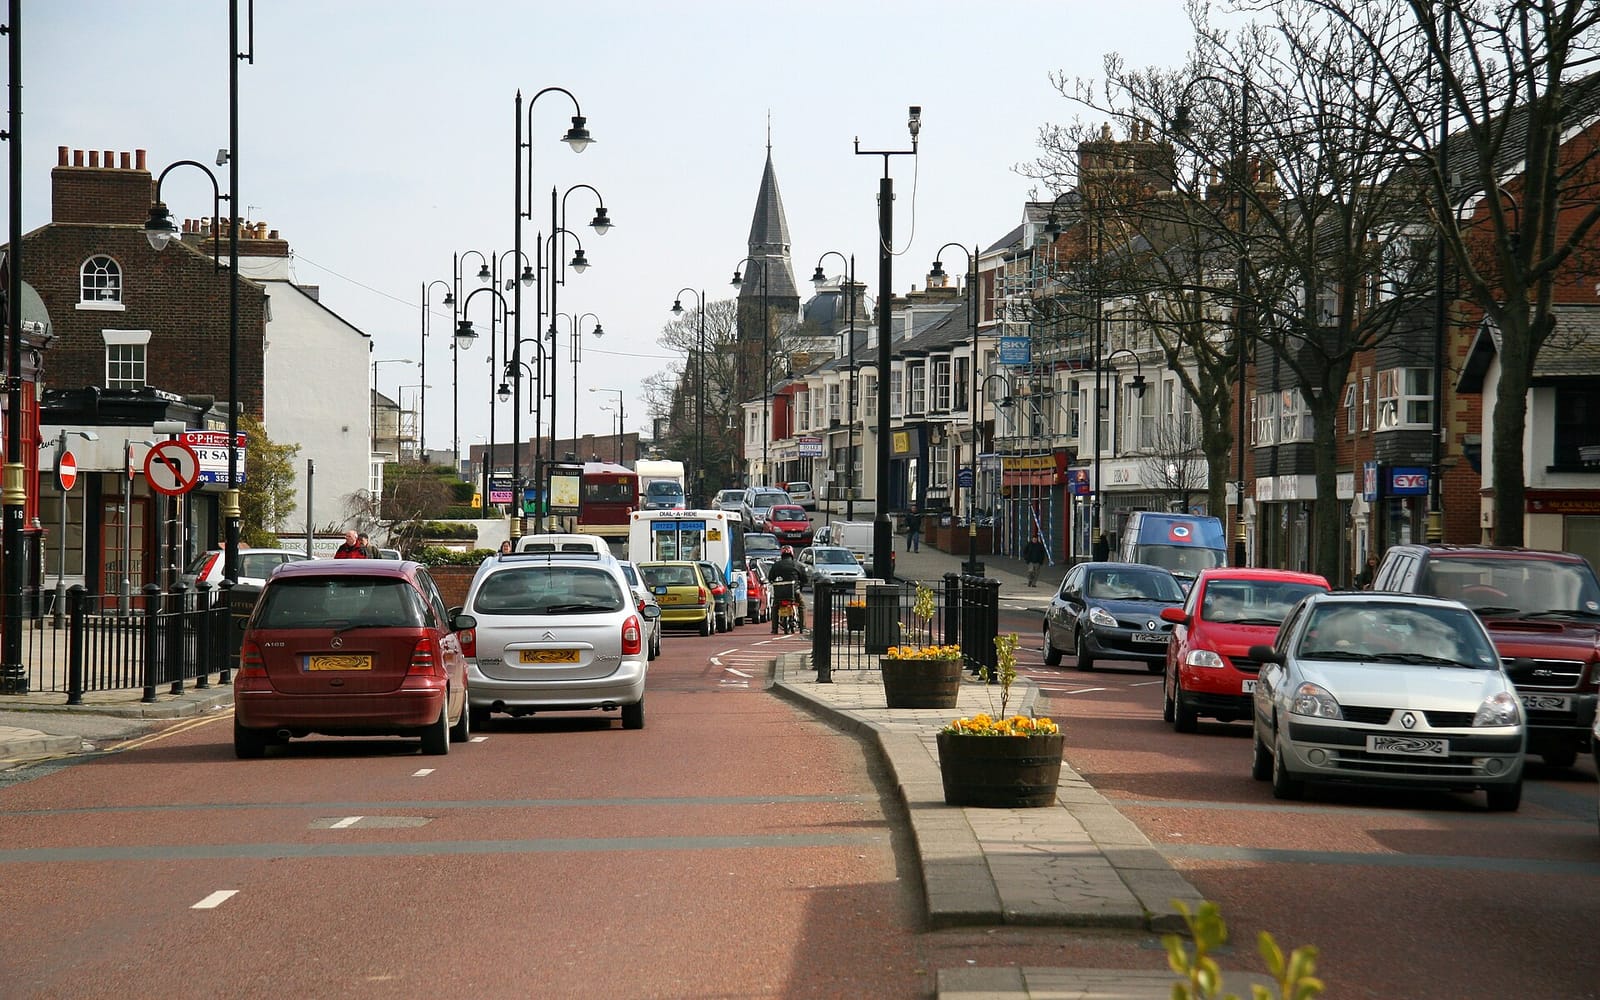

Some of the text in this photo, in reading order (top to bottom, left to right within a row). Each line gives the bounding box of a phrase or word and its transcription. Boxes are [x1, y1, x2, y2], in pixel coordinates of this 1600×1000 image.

[1002, 341, 1026, 349] SKY
[211, 450, 243, 461] SAE
[1394, 475, 1424, 487] EYG
